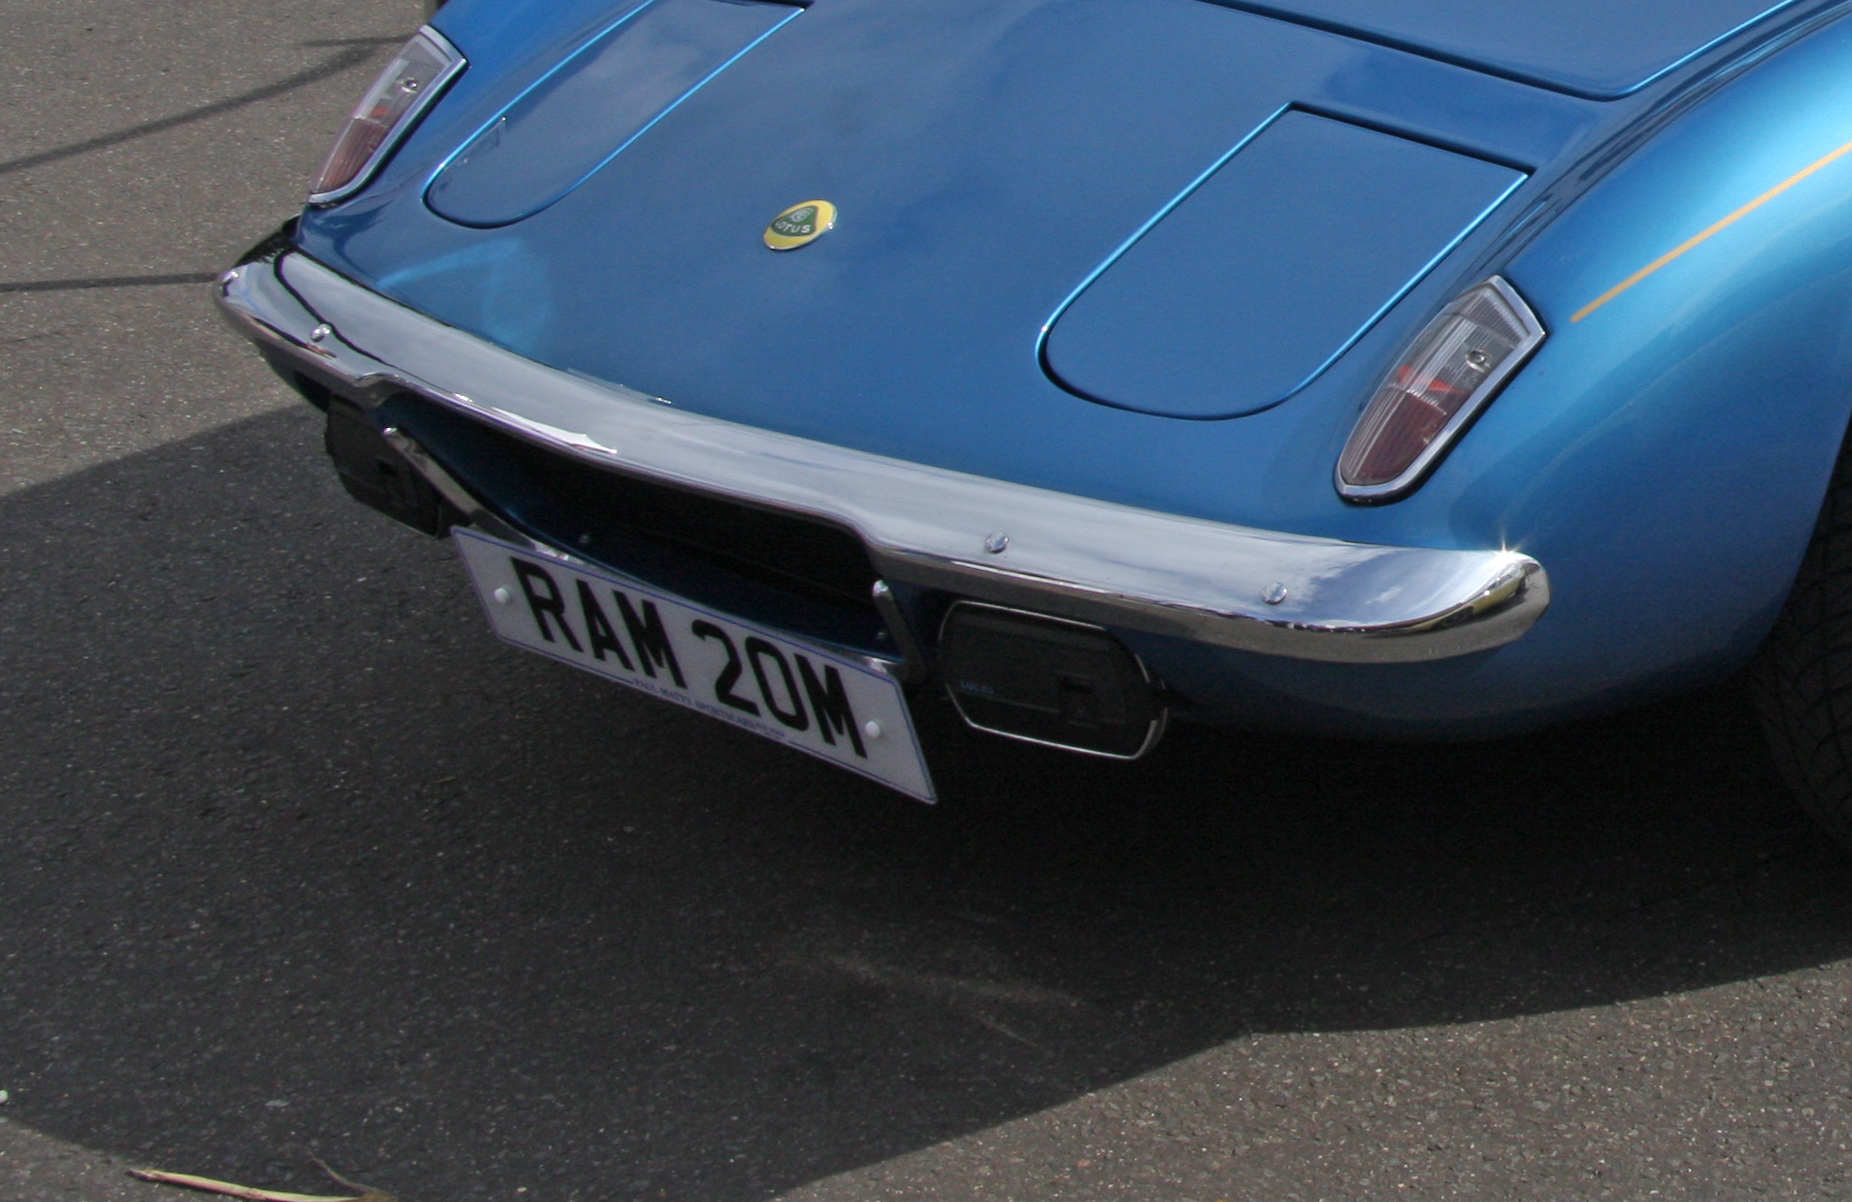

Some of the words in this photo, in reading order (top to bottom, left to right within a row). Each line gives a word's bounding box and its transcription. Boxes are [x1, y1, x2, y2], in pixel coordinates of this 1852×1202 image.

[775, 219, 811, 234] LOTUS
[509, 556, 688, 690] RAM
[691, 618, 868, 759] 20M
